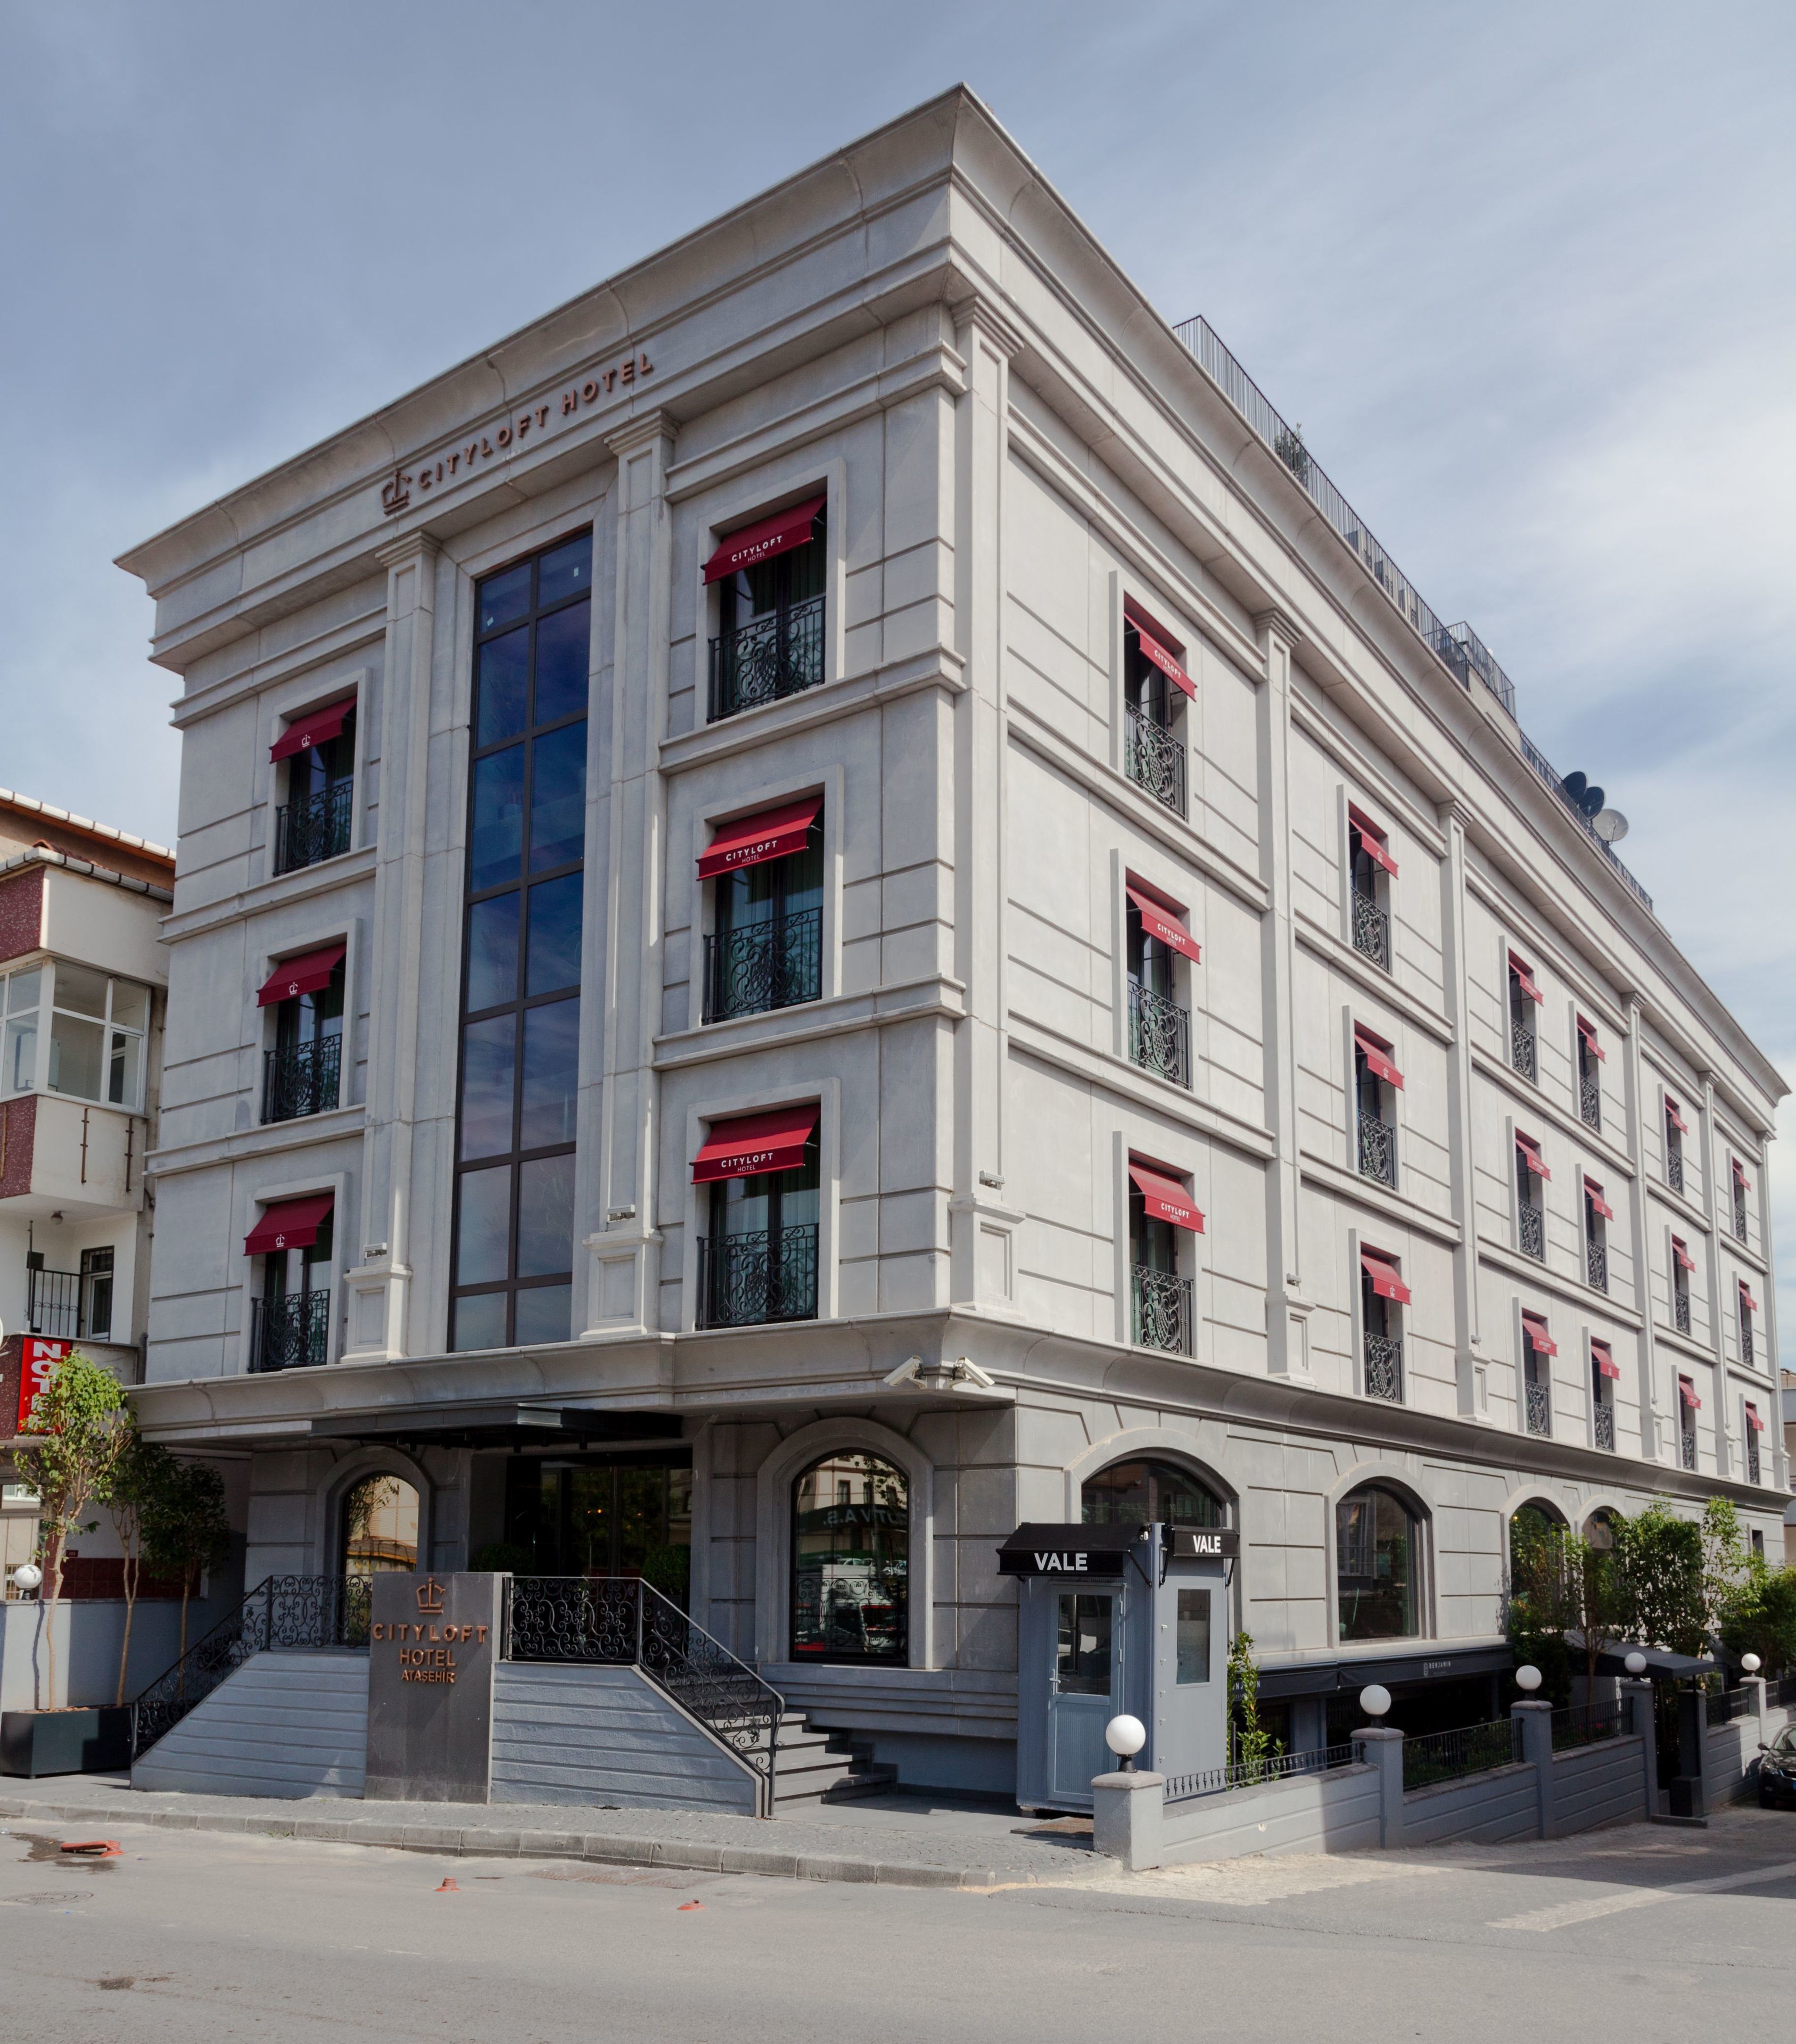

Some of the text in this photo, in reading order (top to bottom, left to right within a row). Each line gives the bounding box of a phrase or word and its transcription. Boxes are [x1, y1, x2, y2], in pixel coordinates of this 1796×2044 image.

[418, 353, 654, 489] CITYLOFT HOTEL
[731, 535, 782, 562] CITYLOFT
[747, 552, 765, 562] HOTEL
[1154, 649, 1182, 679] CITYLOFT
[726, 840, 778, 861] CITYLOFT
[742, 854, 760, 863] HOTEL
[1157, 924, 1185, 945] CITYLOFT
[721, 1152, 773, 1168] CITYLOFT
[1161, 1203, 1190, 1218] CITYLOFT
[1192, 1535, 1222, 1553] VALE
[1034, 1553, 1088, 1571] VALE
[373, 1623, 488, 1643] CITYLOFT
[399, 1648, 457, 1667] HOTEL
[401, 1668, 456, 1683] ATAŞEHİR
